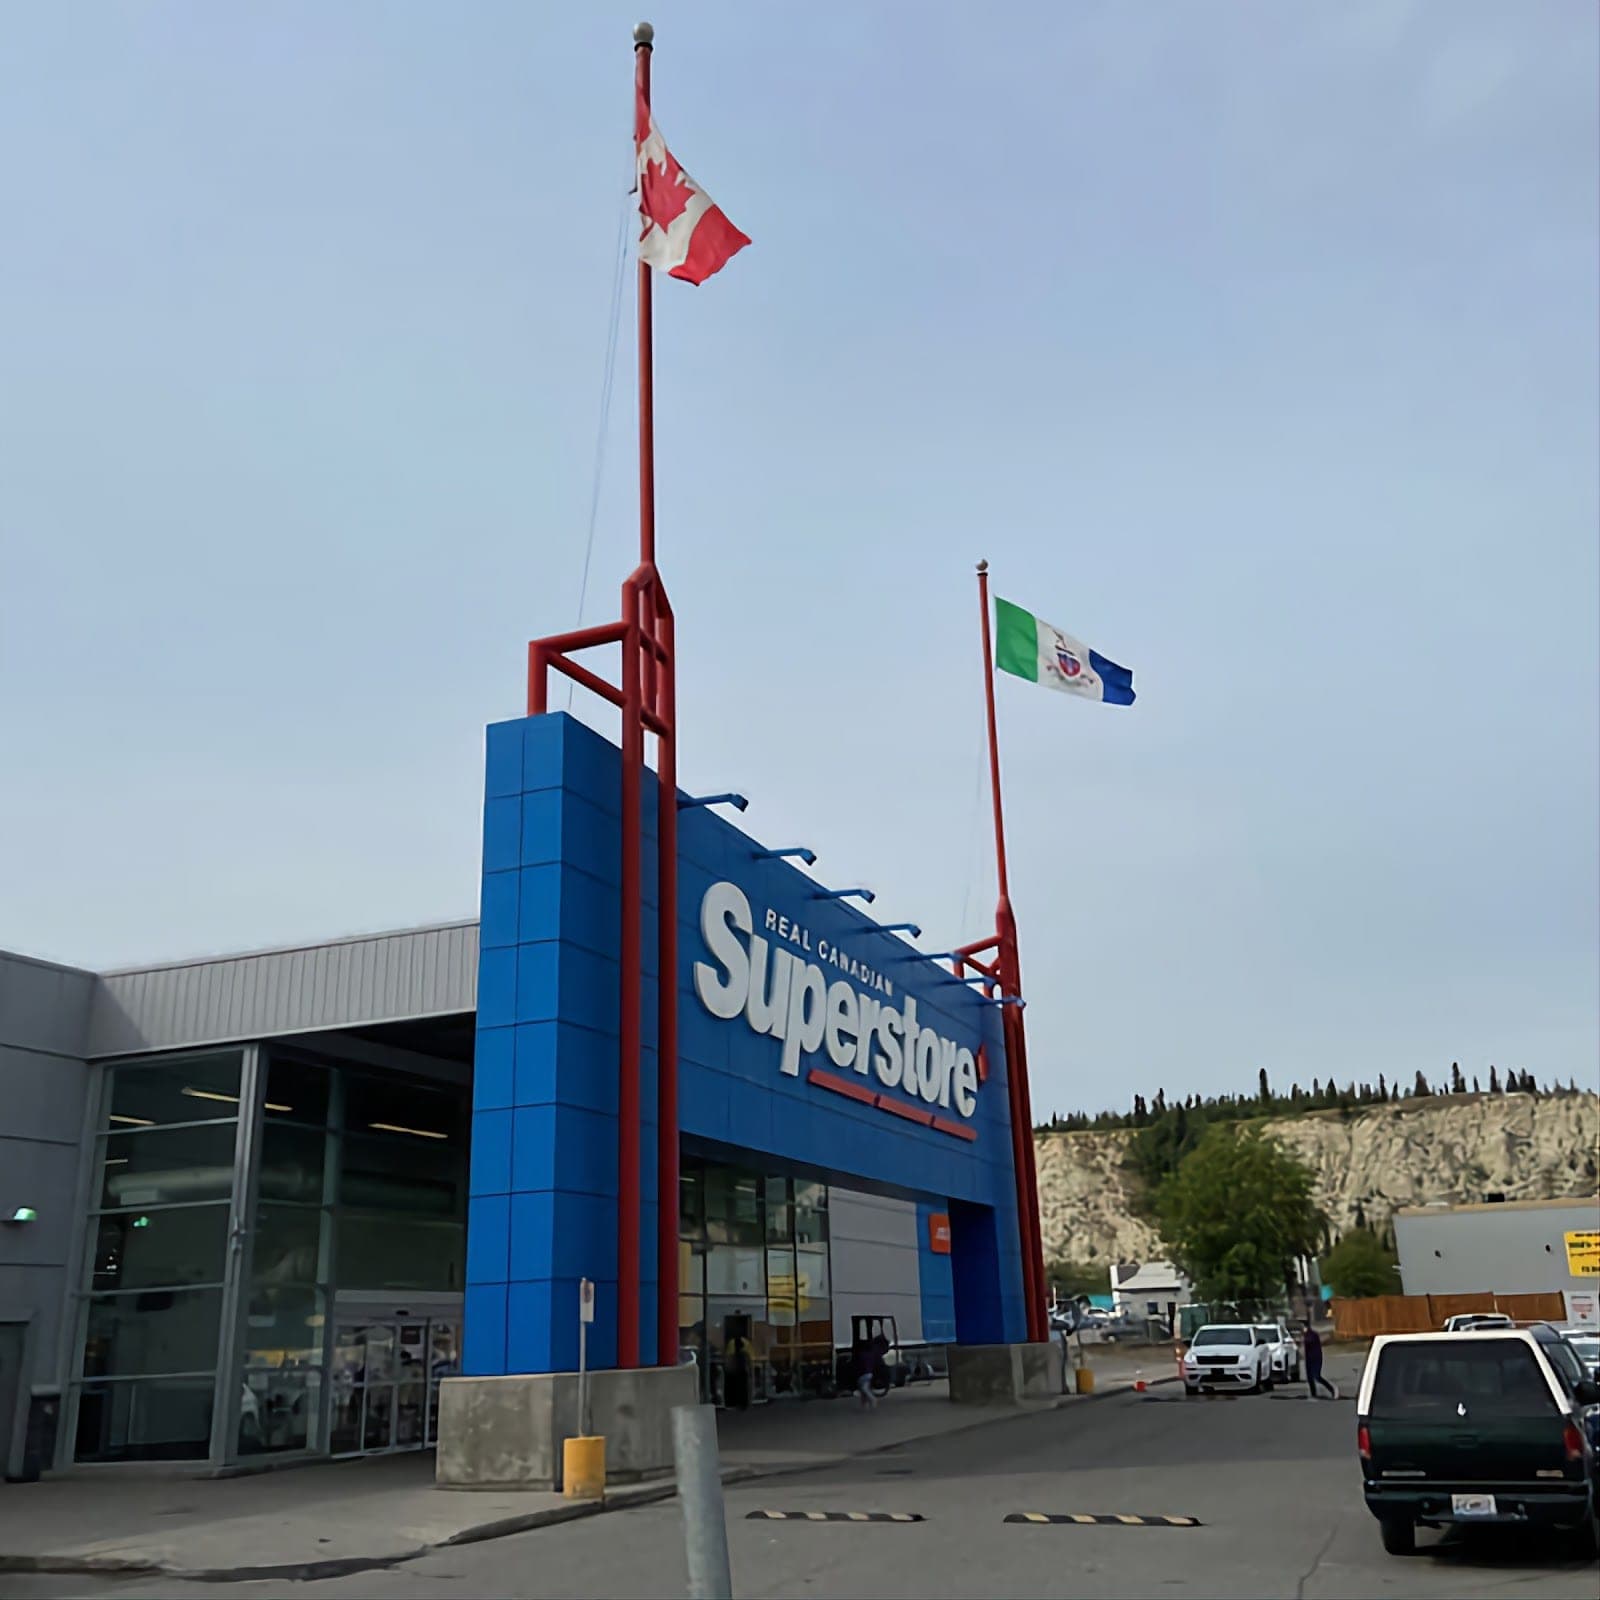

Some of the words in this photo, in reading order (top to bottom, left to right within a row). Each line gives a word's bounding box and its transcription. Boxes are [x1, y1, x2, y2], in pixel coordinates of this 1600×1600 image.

[693, 881, 978, 1118] Superstore
[765, 908, 811, 951] REAL
[818, 940, 893, 997] CANADIAN
